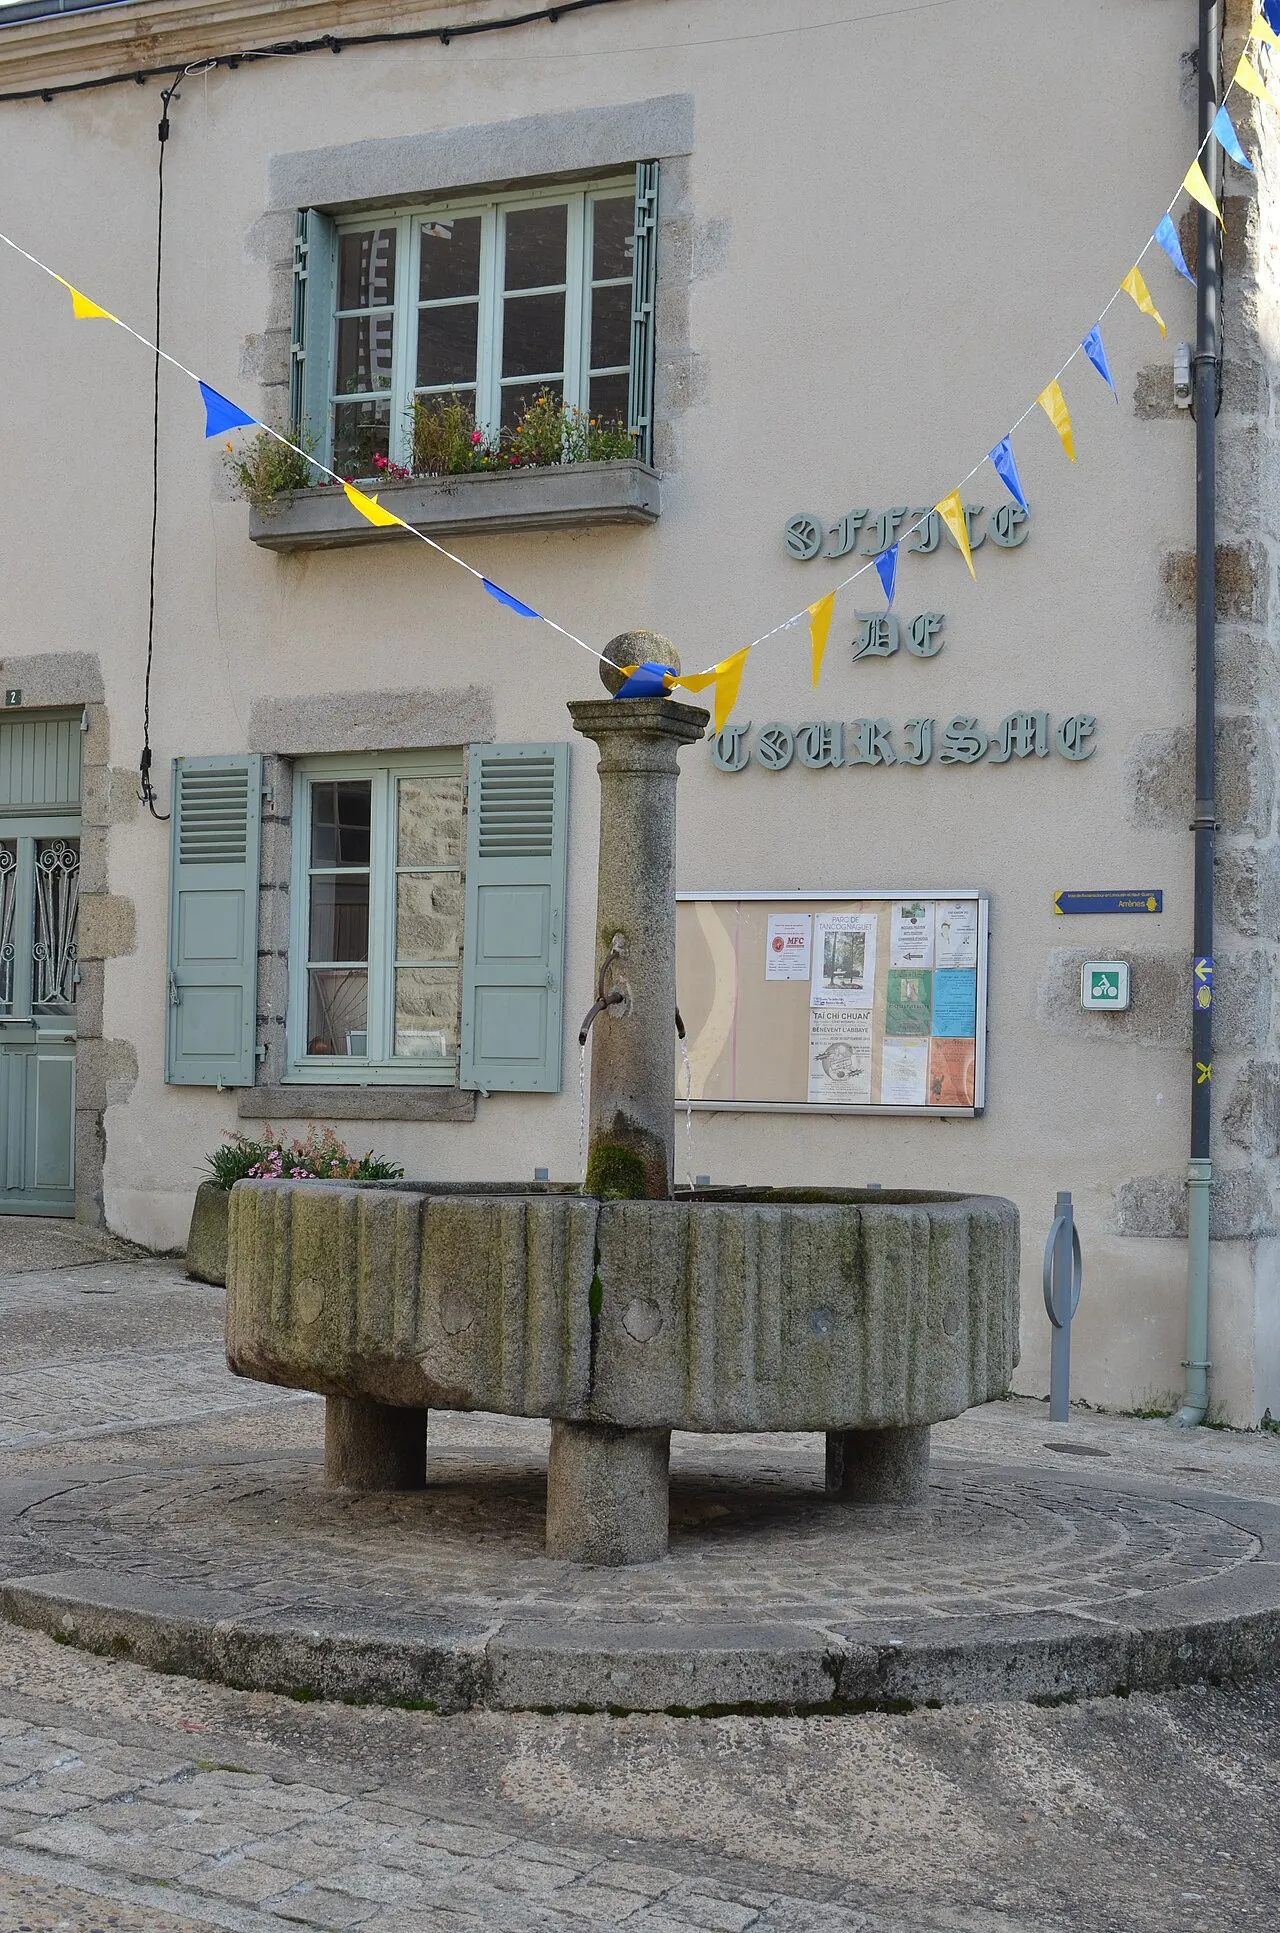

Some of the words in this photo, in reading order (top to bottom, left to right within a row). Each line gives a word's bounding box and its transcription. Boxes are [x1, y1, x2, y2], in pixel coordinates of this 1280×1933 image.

[852, 608, 946, 663] DE
[10, 691, 16, 703] 2
[706, 709, 1098, 772] TOURISME
[1118, 899, 1145, 907] Arrènes
[820, 923, 873, 931] TANCOGNAGUET
[787, 937, 804, 945] MFC
[827, 1011, 840, 1019] CHI
